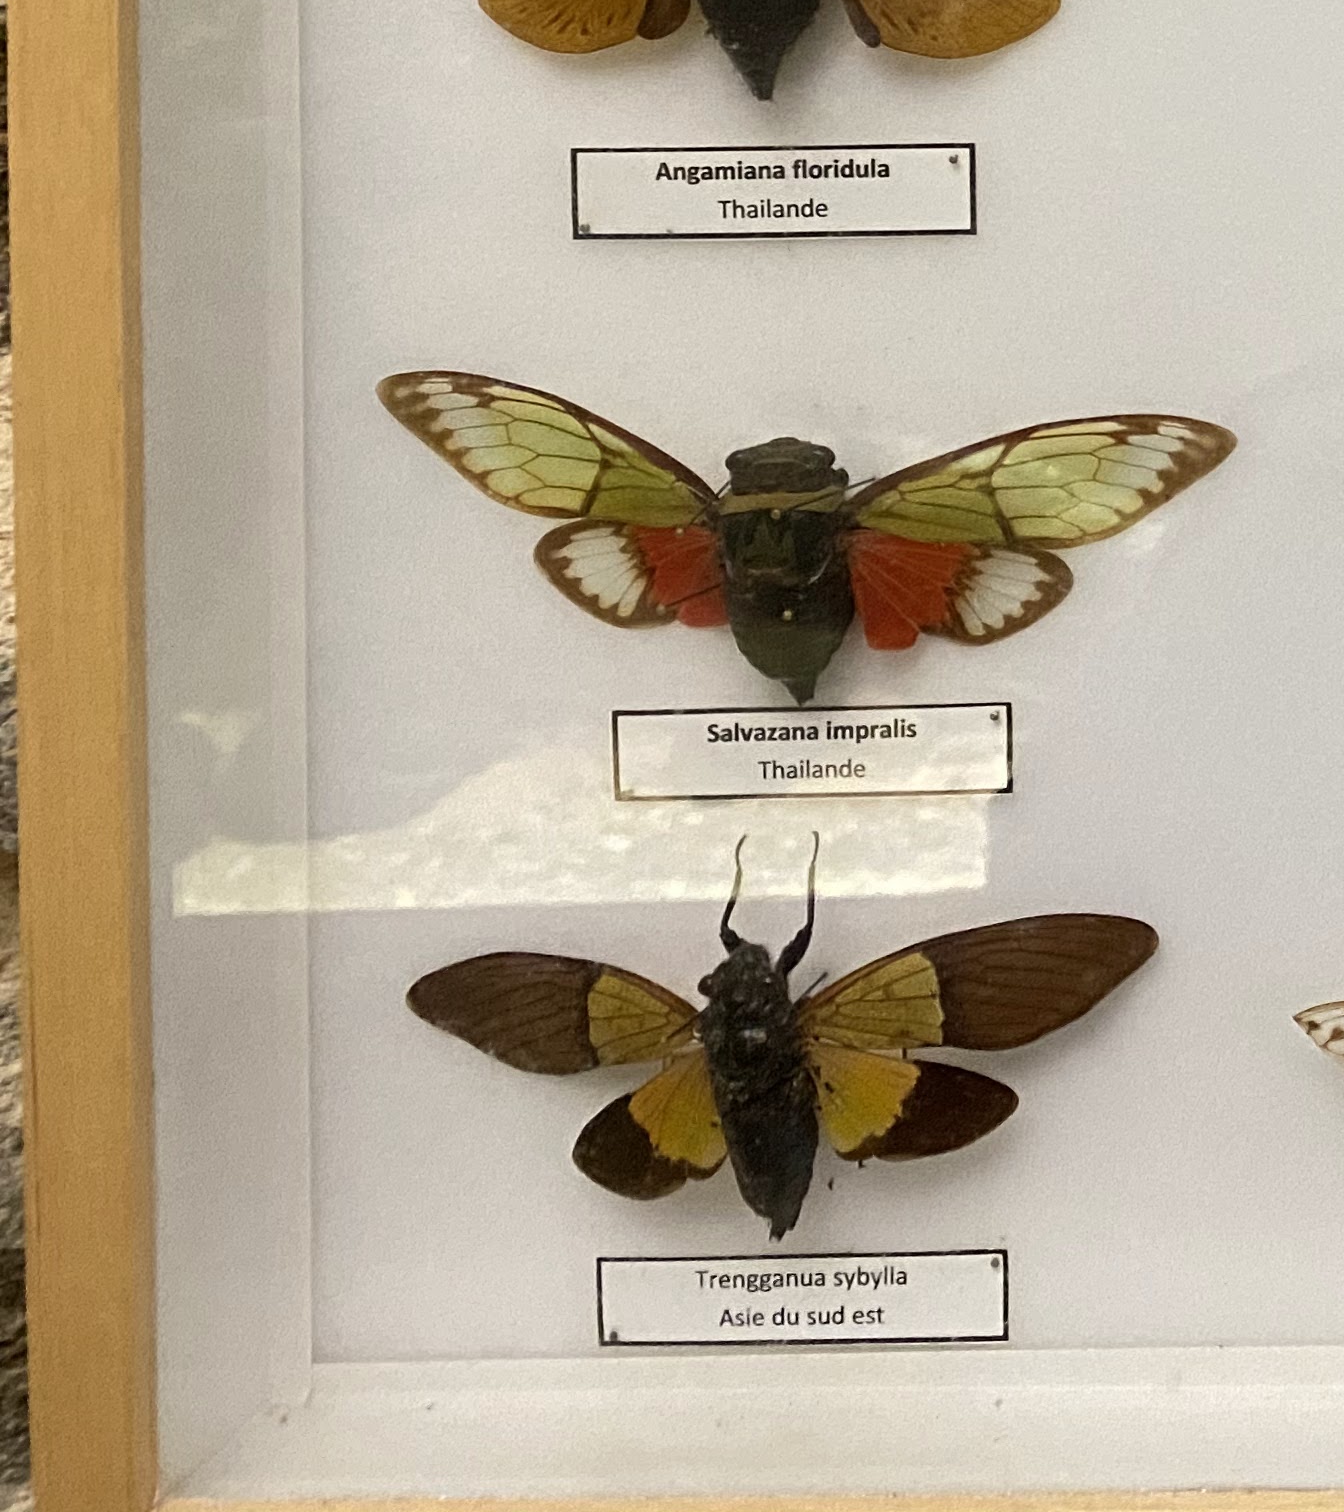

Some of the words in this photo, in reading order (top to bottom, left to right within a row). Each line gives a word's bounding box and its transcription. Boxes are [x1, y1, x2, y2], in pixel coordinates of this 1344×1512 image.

[656, 161, 786, 185] Angamiana
[792, 158, 891, 180] floridula
[717, 197, 829, 219] Thailande
[706, 723, 820, 743] Salvazana
[827, 718, 918, 744] impralis
[757, 758, 867, 781] Thailande
[695, 1269, 827, 1294] Trengganua
[833, 1265, 909, 1292] sybylla
[719, 1307, 766, 1328] Asie
[772, 1304, 800, 1327] du
[807, 1304, 846, 1327] sud
[852, 1306, 886, 1326] est
